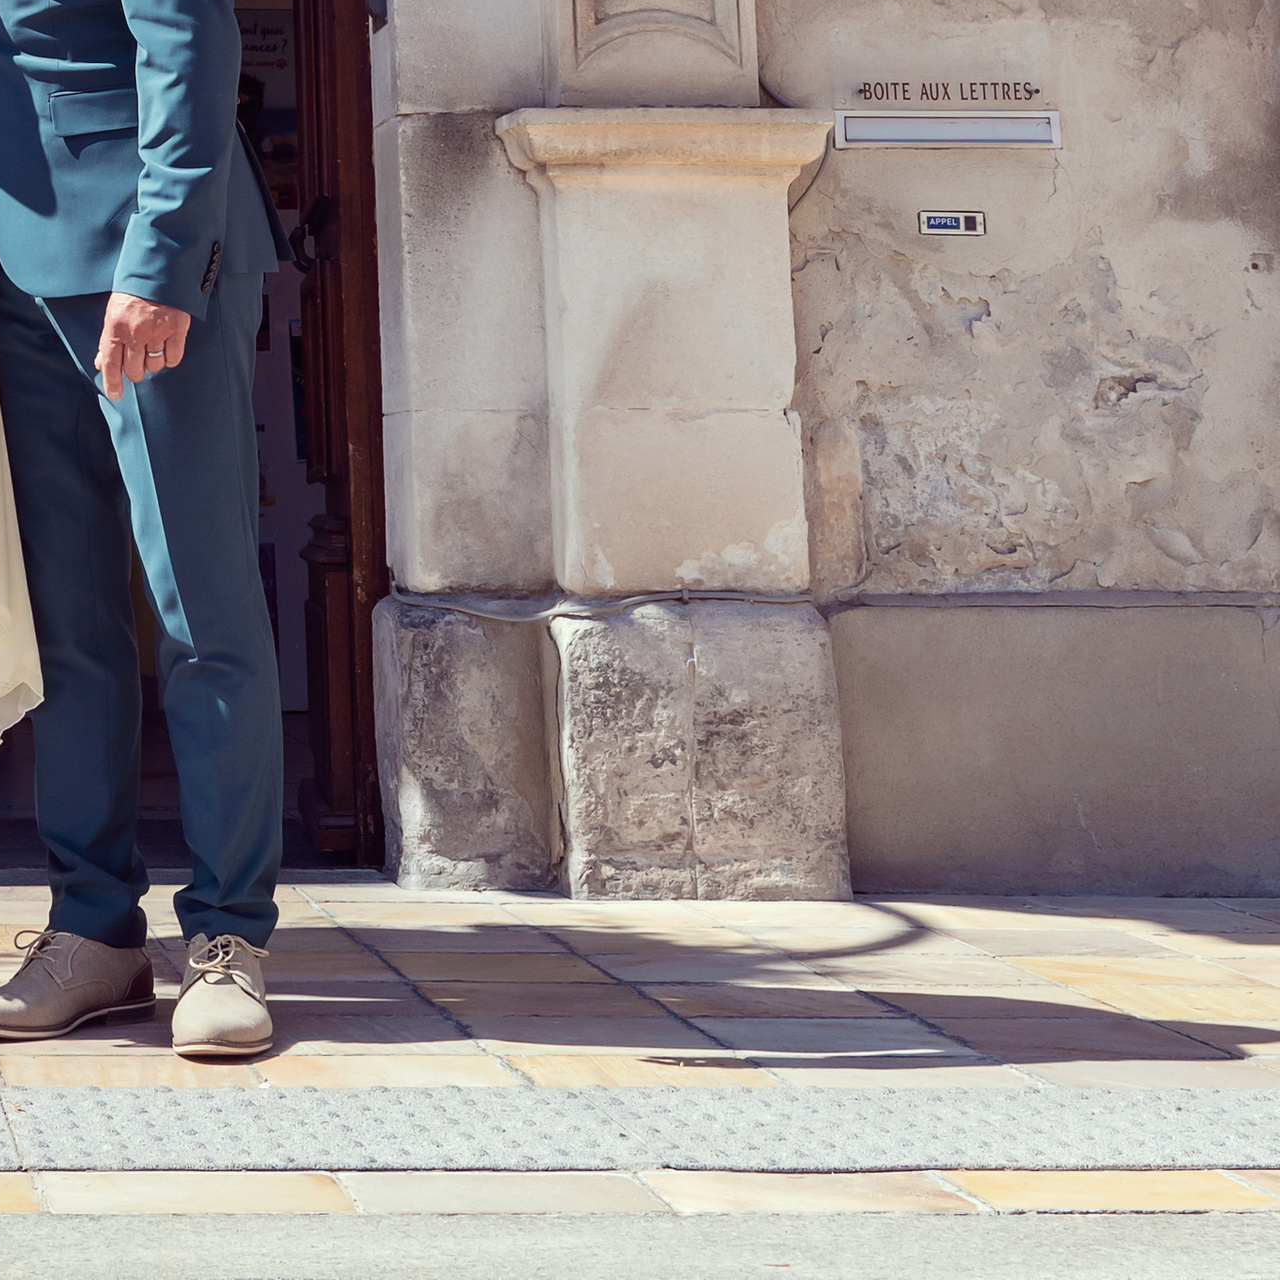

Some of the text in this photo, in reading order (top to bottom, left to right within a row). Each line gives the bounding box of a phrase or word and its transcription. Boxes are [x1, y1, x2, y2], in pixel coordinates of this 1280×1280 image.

[260, 26, 284, 41] quoi
[241, 44, 279, 52] ances
[862, 82, 1033, 101] BOITE AUX LETTRES
[929, 217, 958, 226] APPEL
